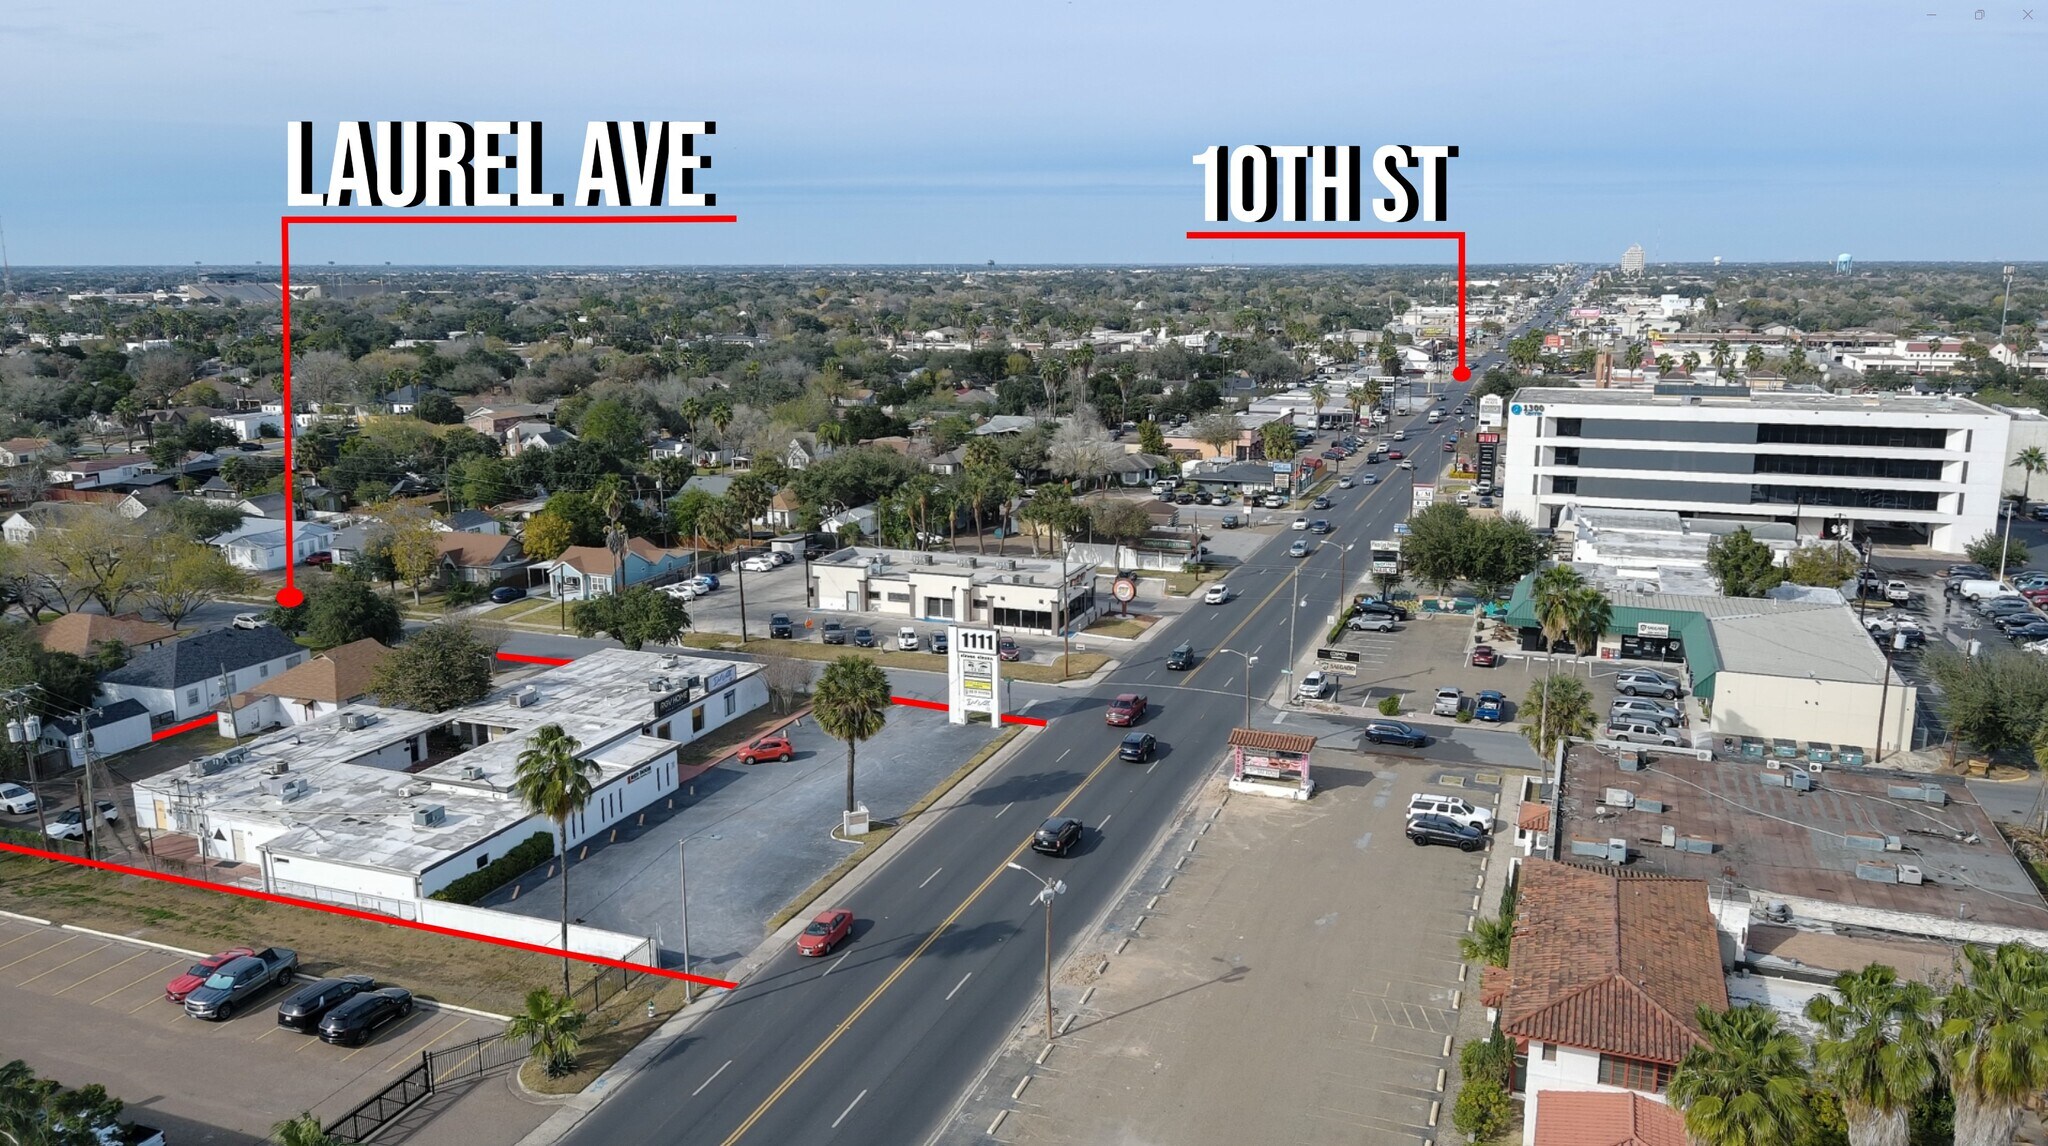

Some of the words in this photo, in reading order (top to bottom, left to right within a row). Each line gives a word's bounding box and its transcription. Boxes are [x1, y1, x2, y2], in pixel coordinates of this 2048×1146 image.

[961, 632, 993, 650] 1111
[1330, 662, 1356, 671] SALGADO
[660, 699, 673, 710] RGV
[672, 691, 688, 704] HOME
